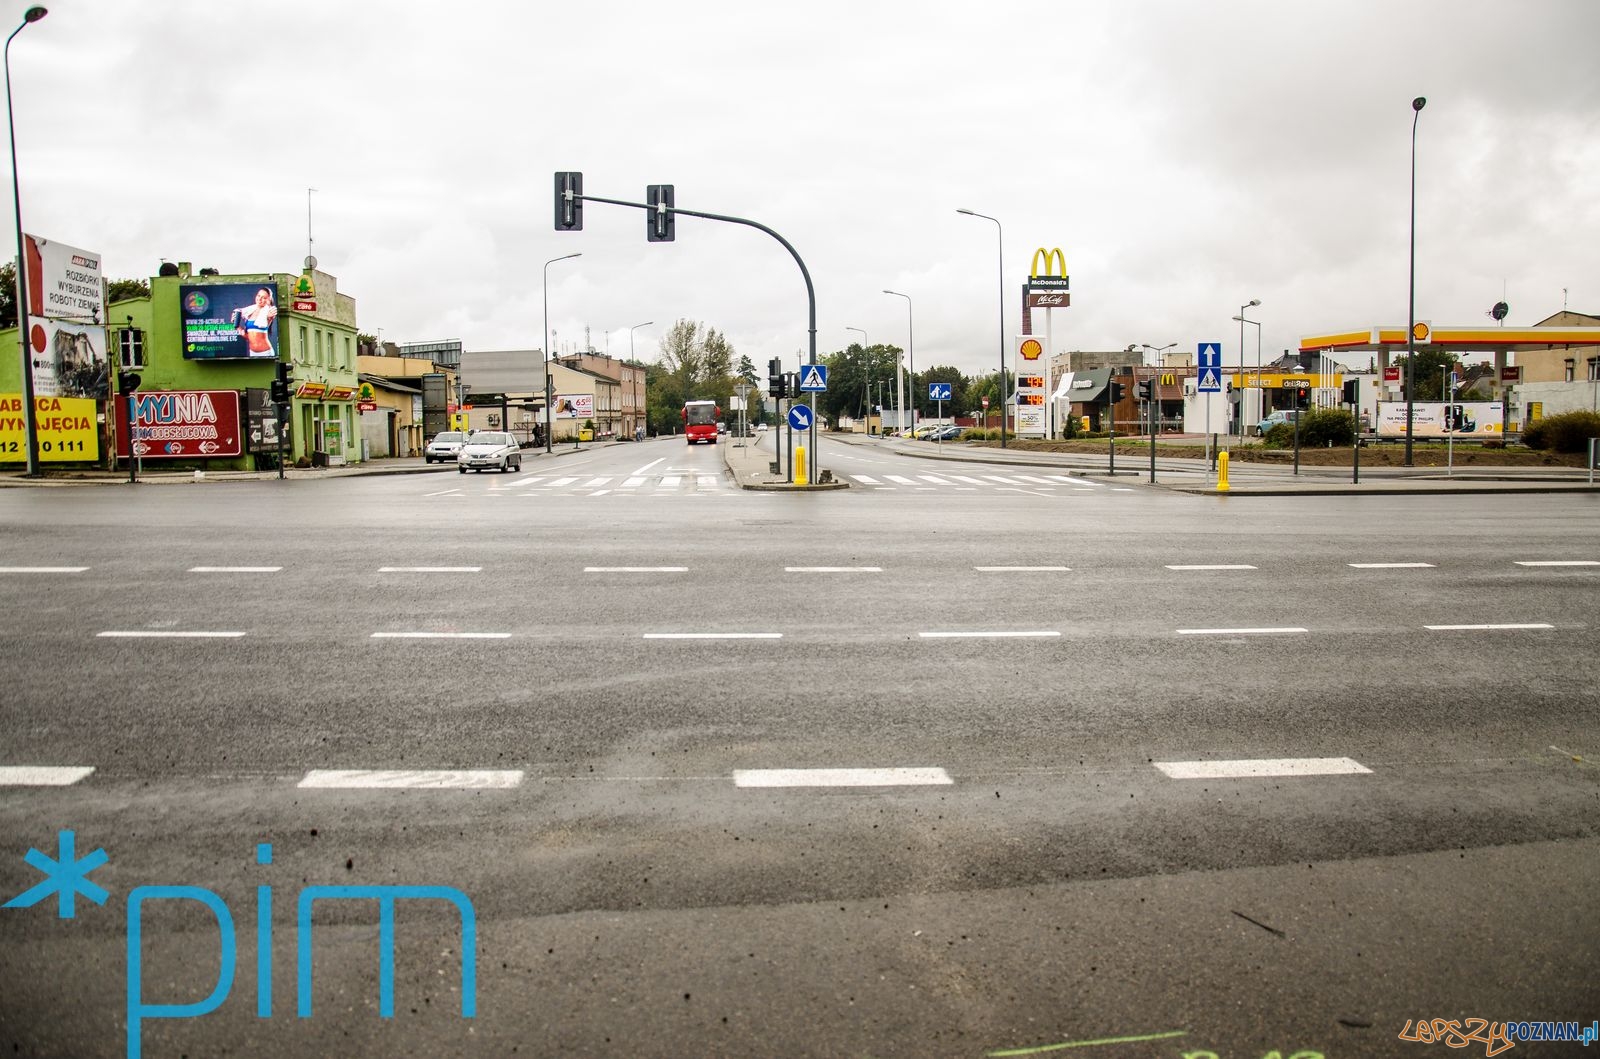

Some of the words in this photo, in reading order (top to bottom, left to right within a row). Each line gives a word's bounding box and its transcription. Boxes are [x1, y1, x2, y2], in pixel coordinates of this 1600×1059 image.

[66, 269, 99, 287] ROZBIÓRKI
[58, 280, 100, 299] WYBURZENIA
[49, 292, 77, 307] ROBOTY
[78, 298, 100, 310] ZIEMNE
[130, 394, 218, 424] MYJNIA
[58, 440, 83, 452] 111
